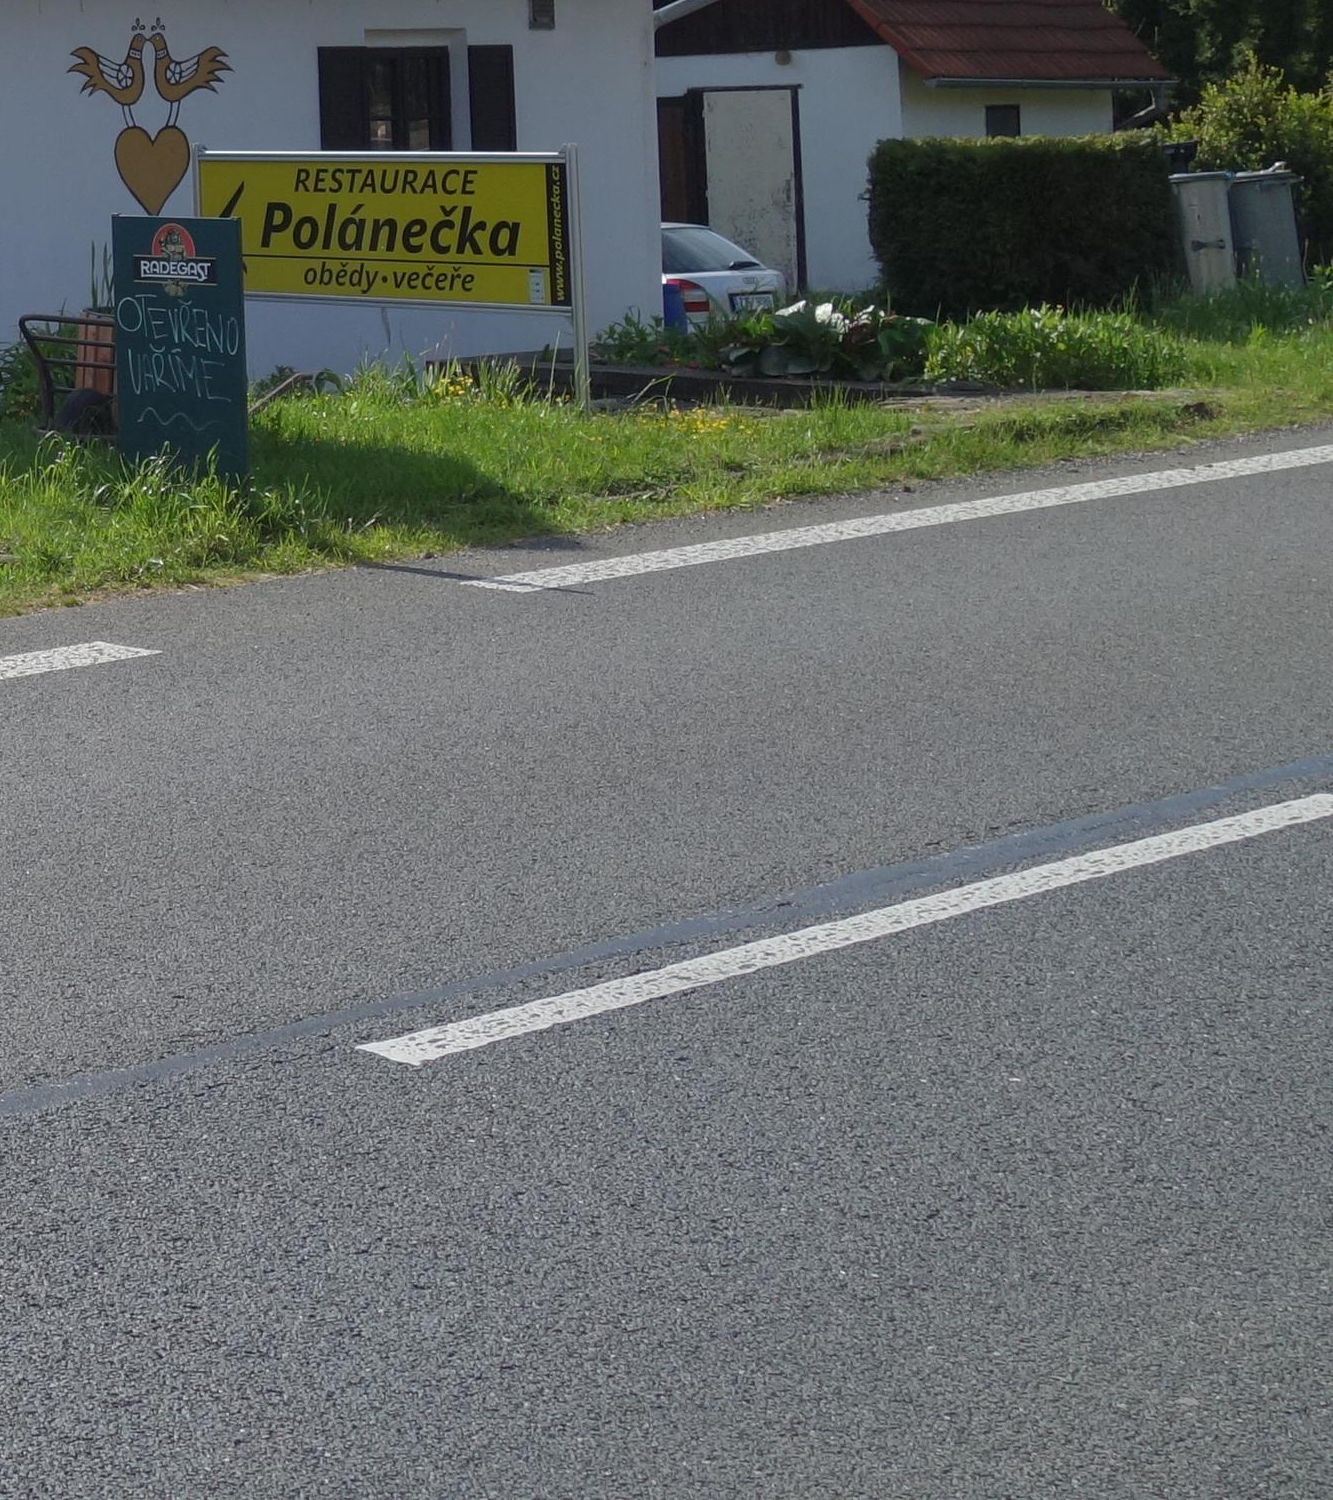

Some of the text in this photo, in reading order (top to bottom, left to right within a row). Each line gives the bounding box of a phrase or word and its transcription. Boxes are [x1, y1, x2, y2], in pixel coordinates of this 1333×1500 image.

[294, 168, 478, 195] RESTAURACE
[261, 202, 520, 257] Polánečka
[550, 165, 565, 301] www.polanecka.cz
[140, 260, 211, 282] RADEGAST
[117, 294, 239, 356] OTEVŘENO
[128, 343, 231, 402] VAŘÍME
